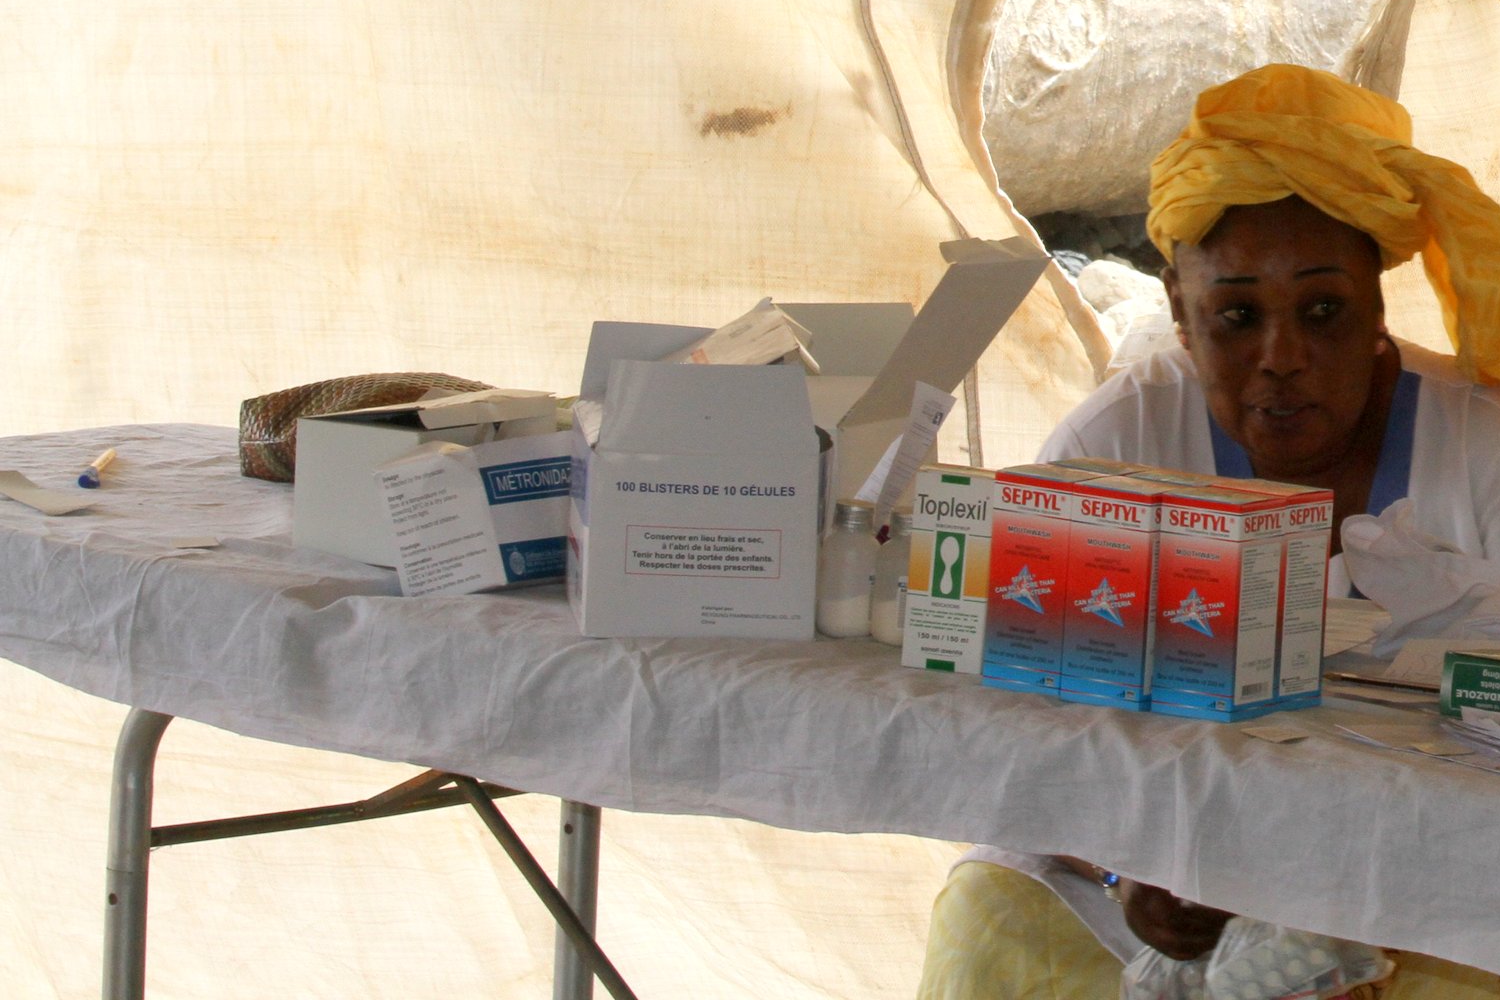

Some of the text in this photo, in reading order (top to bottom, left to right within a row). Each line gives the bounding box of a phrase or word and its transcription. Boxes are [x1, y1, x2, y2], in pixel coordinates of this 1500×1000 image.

[616, 482, 796, 497] 100 BLISTERS DE 10 GÉLULES
[918, 494, 986, 521] Toplexil
[644, 532, 686, 541] Conserver
[688, 534, 699, 542] en
[700, 534, 716, 542] lieu
[717, 534, 736, 543] frais
[692, 543, 702, 551] de
[704, 544, 711, 552] la
[632, 550, 652, 559] Tenir
[654, 552, 674, 560] hors
[676, 552, 686, 560] de
[697, 552, 722, 562] portée
[725, 554, 740, 562] des
[742, 554, 774, 564] enfants.
[640, 560, 766, 574] Respecter les doses prescrites.
[918, 632, 930, 640] 150
[946, 634, 959, 643] 150
[961, 635, 969, 644] ml
